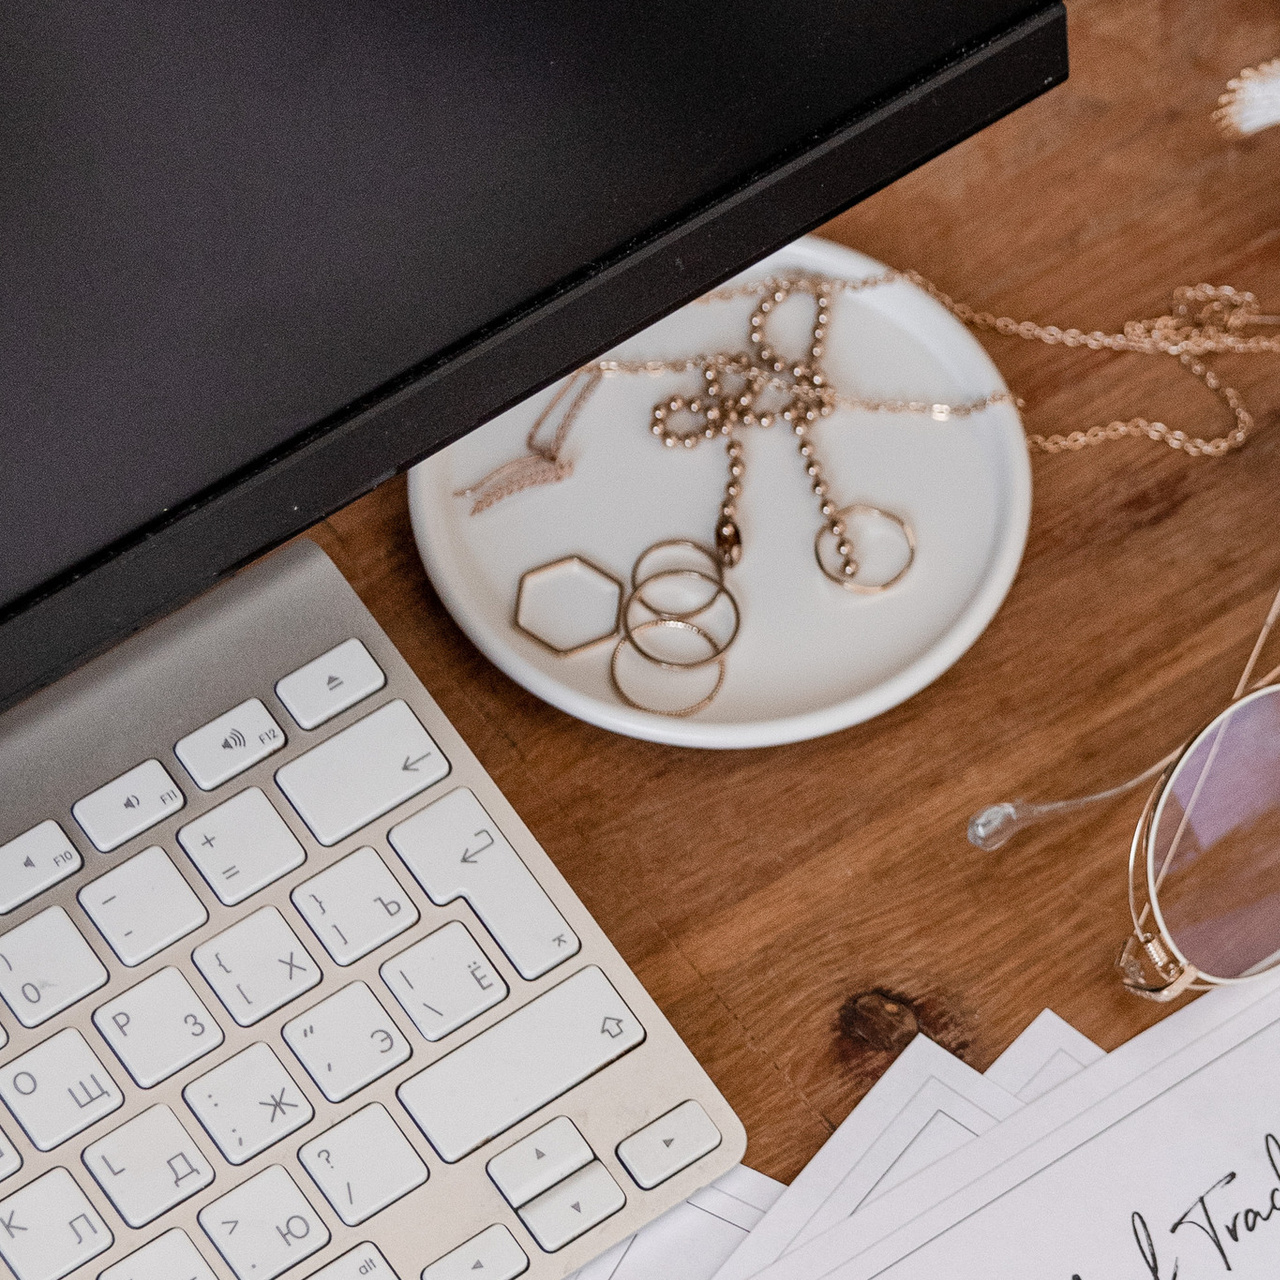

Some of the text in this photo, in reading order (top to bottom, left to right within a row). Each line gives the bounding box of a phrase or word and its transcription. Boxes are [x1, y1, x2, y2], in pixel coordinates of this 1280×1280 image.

[259, 727, 280, 747] F12
[160, 788, 179, 807] F11
[53, 849, 74, 869] F10
[258, 1087, 300, 1123] Ж
[166, 1151, 201, 1188] Д
[275, 1214, 311, 1247] Ю
[358, 1256, 378, 1277] alt
